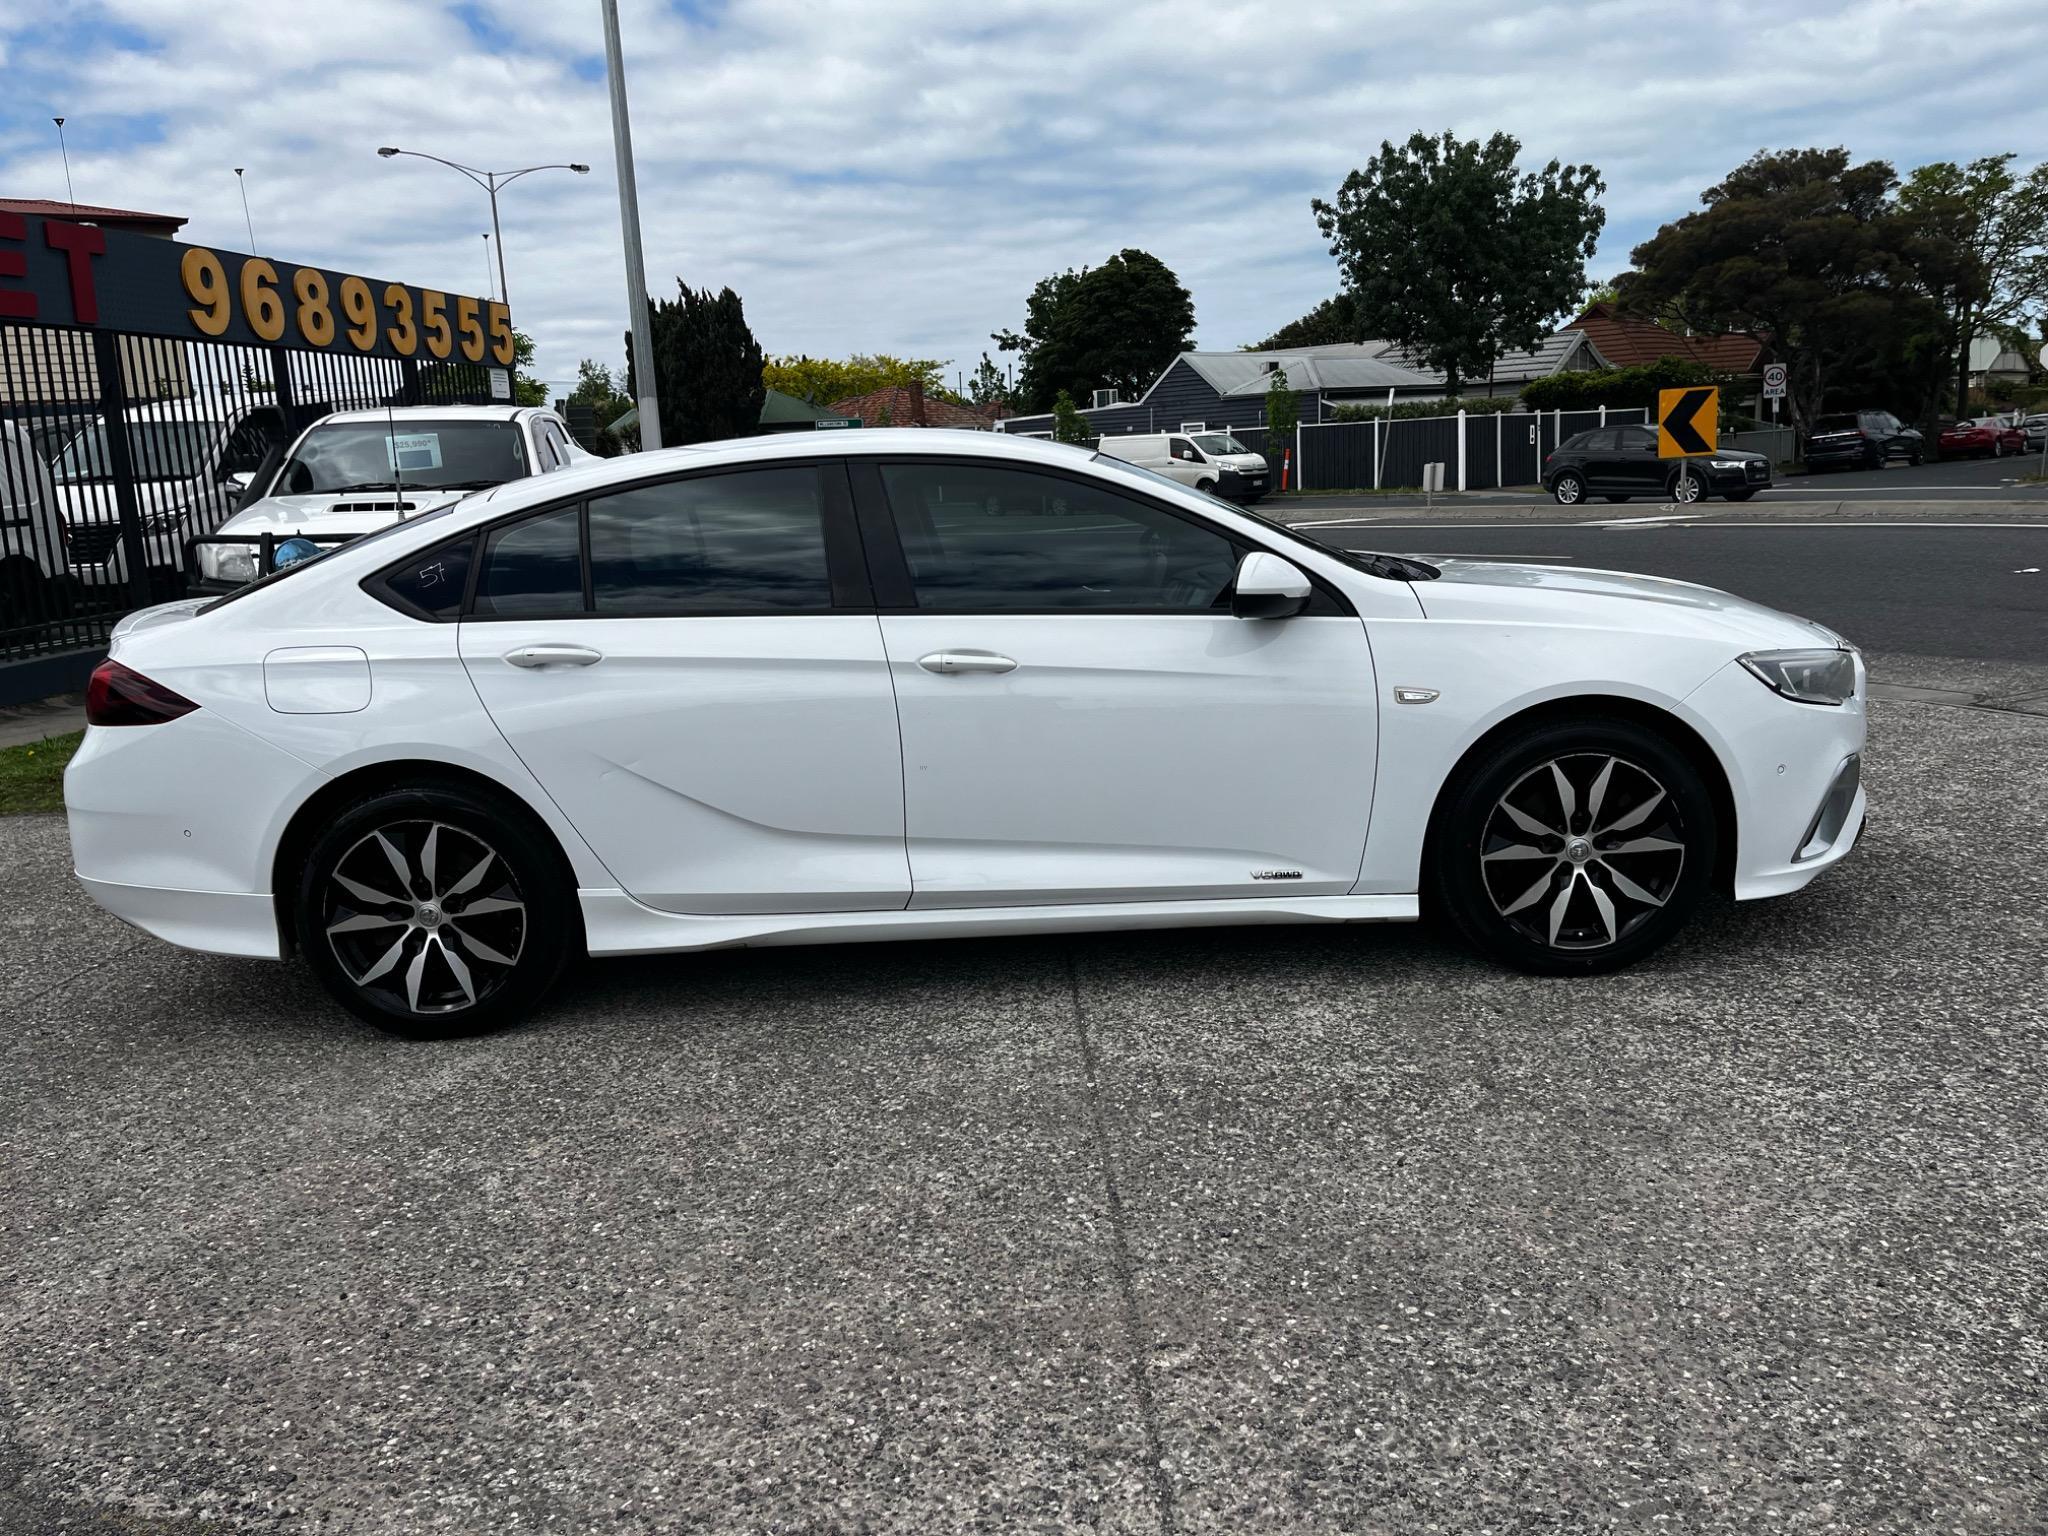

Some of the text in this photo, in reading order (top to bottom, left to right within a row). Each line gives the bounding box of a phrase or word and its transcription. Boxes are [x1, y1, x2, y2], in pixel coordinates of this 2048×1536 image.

[181, 248, 515, 366] 96893555
[1768, 371, 1783, 381] 40
[1764, 388, 1785, 396] AREA
